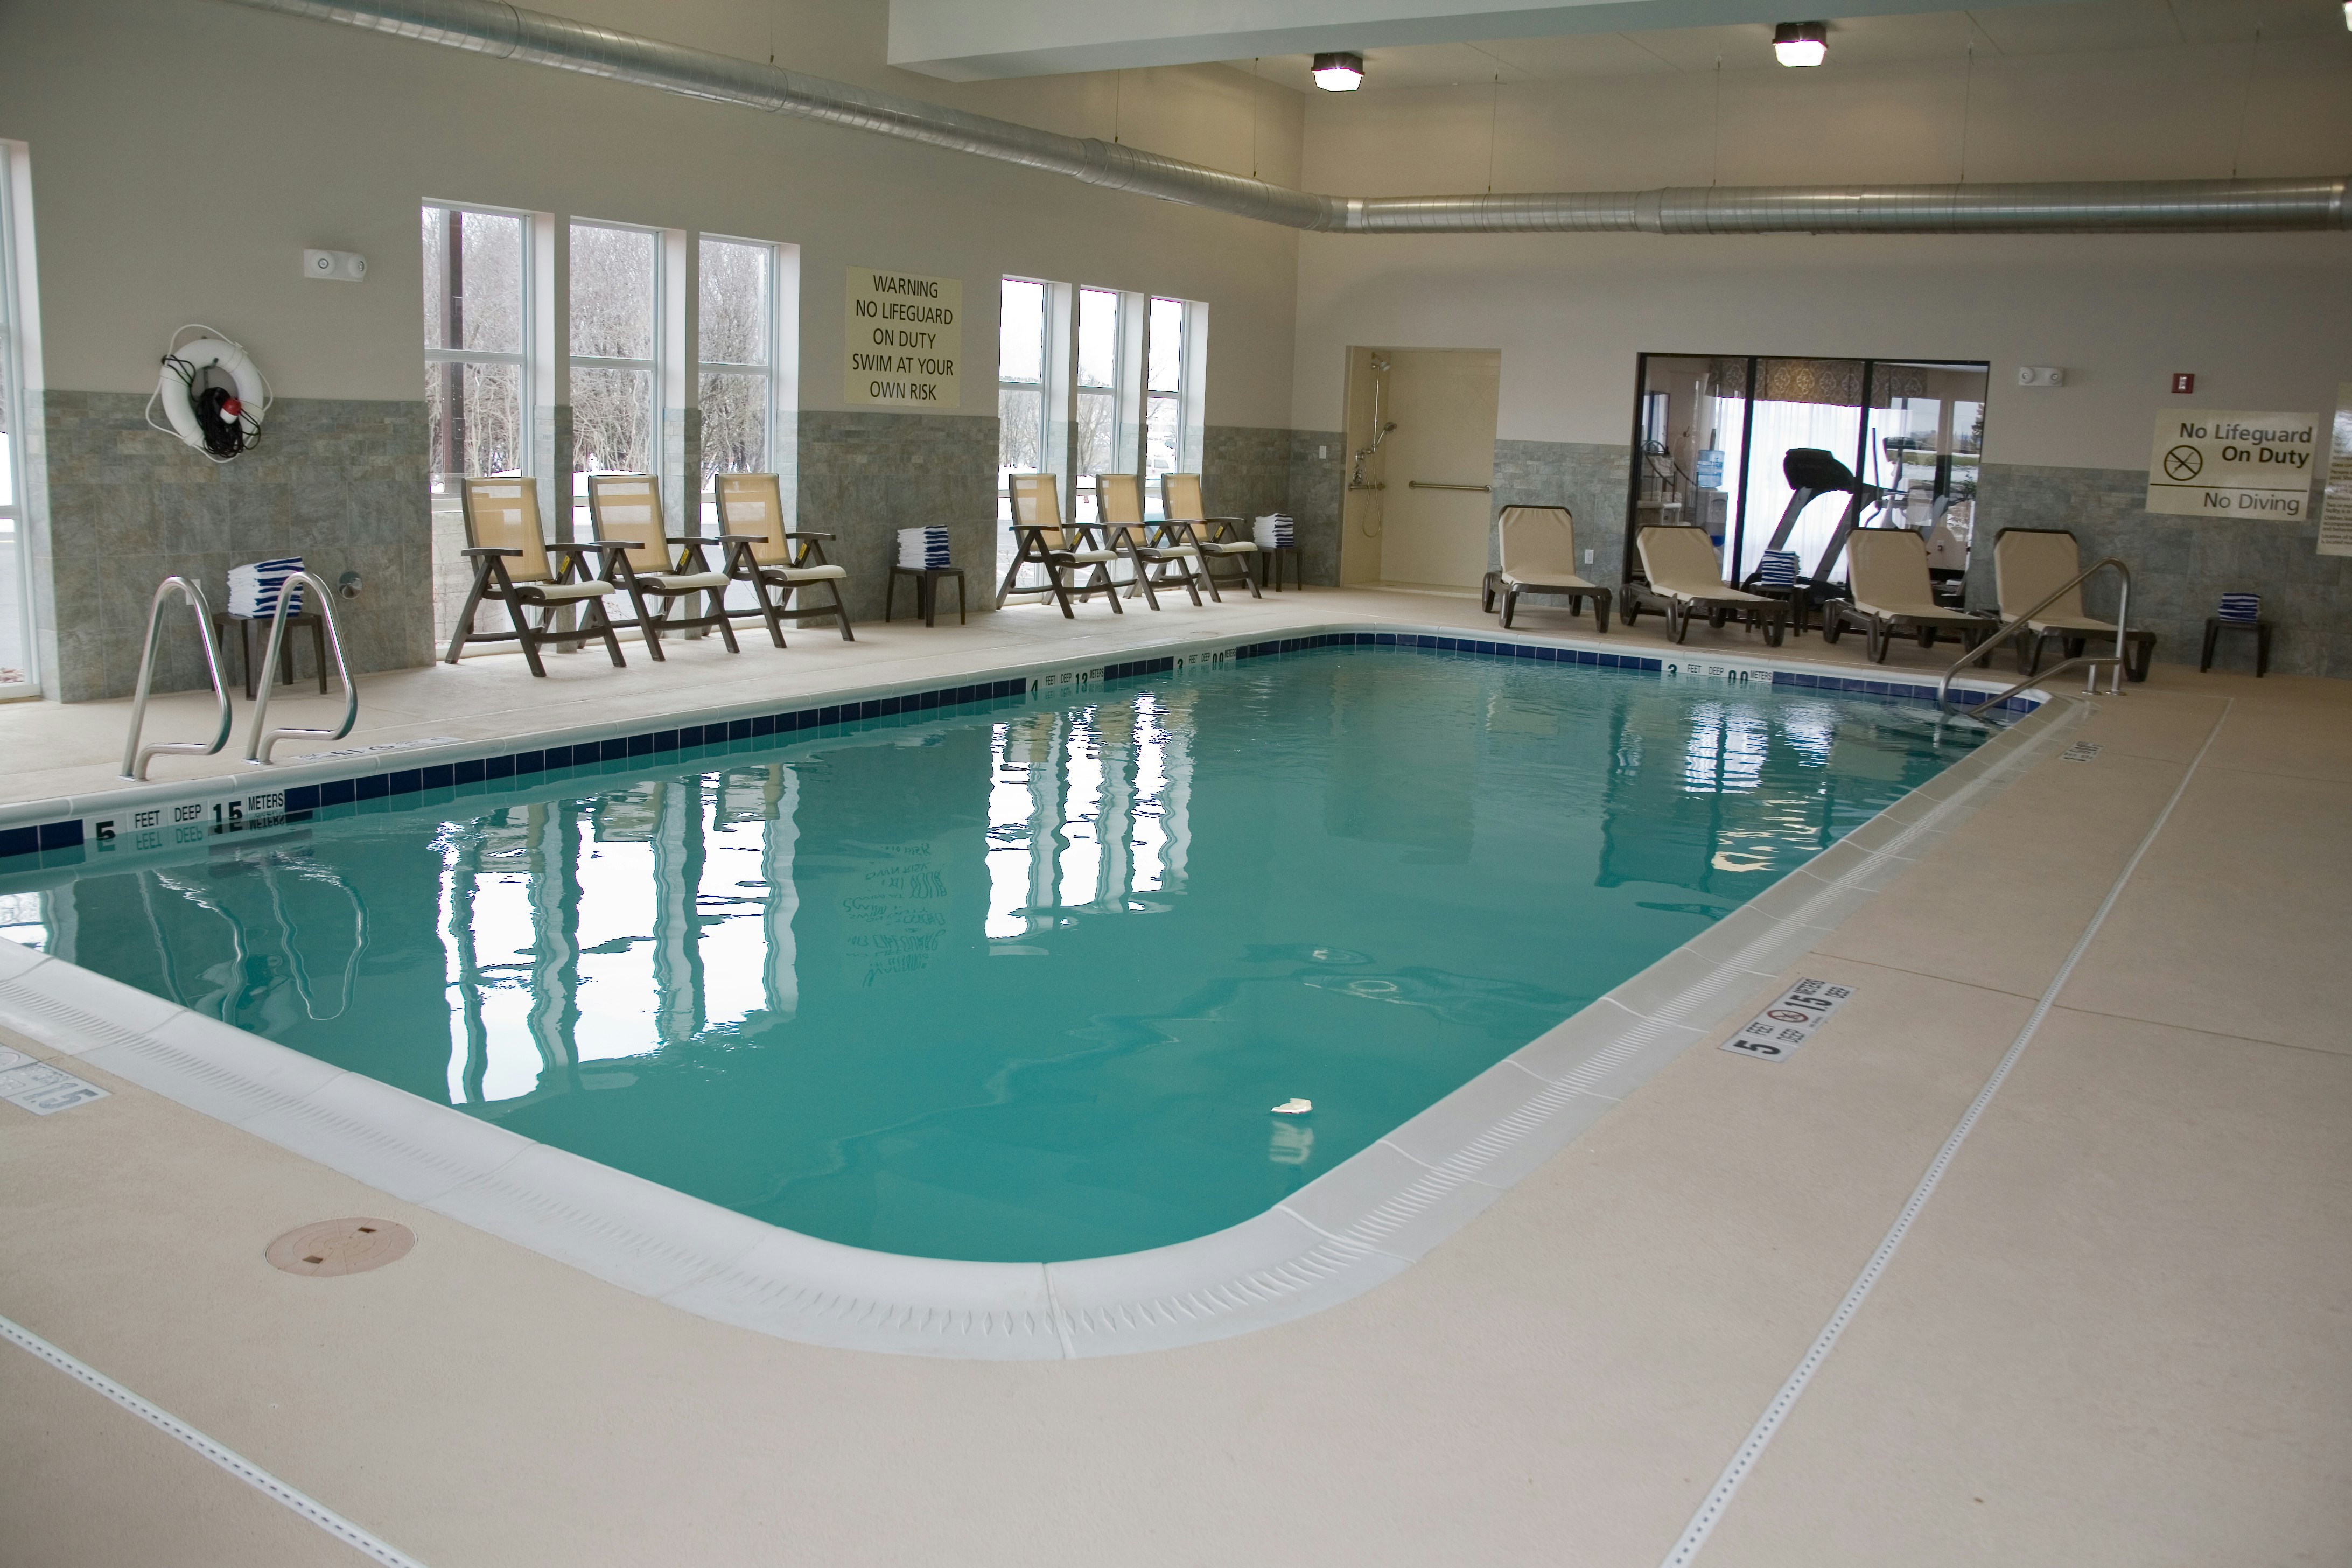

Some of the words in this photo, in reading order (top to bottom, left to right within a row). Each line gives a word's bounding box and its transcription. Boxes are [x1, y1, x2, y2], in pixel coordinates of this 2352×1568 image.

[873, 275, 937, 298] WARNING
[857, 299, 877, 318] NO
[883, 302, 953, 325] LIFEGUARD
[873, 328, 894, 346] ON
[899, 331, 936, 349] DUTY
[852, 353, 892, 372] SWIM
[897, 356, 914, 373] AT
[918, 358, 953, 376] YOUR
[870, 381, 905, 398] OWN
[910, 383, 937, 400] RISK
[2180, 423, 2207, 439] No
[2215, 424, 2313, 445] Lifeguard
[2222, 446, 2251, 462] On
[2259, 447, 2309, 468] Duty
[2203, 492, 2231, 508] No
[2238, 493, 2300, 515] Diving
[1189, 654, 1198, 664] FEET
[1201, 652, 1210, 662] DEEP
[1224, 648, 1237, 658] METERS
[1045, 675, 1056, 685] FEET
[1060, 673, 1072, 683] DEEP
[1089, 668, 1104, 679] METERS
[1687, 664, 1702, 673] FEET
[1709, 666, 1724, 675] DEEP
[1751, 670, 1772, 681] METERS
[96, 820, 116, 840] 5
[135, 810, 160, 828] FEET
[174, 804, 201, 822] DEEP
[248, 793, 284, 811] METERS
[1824, 986, 1850, 999] DEEP
[1745, 1021, 1775, 1036] FEET
[1776, 1028, 1805, 1044] DEEP
[1733, 1040, 1781, 1055] 5
